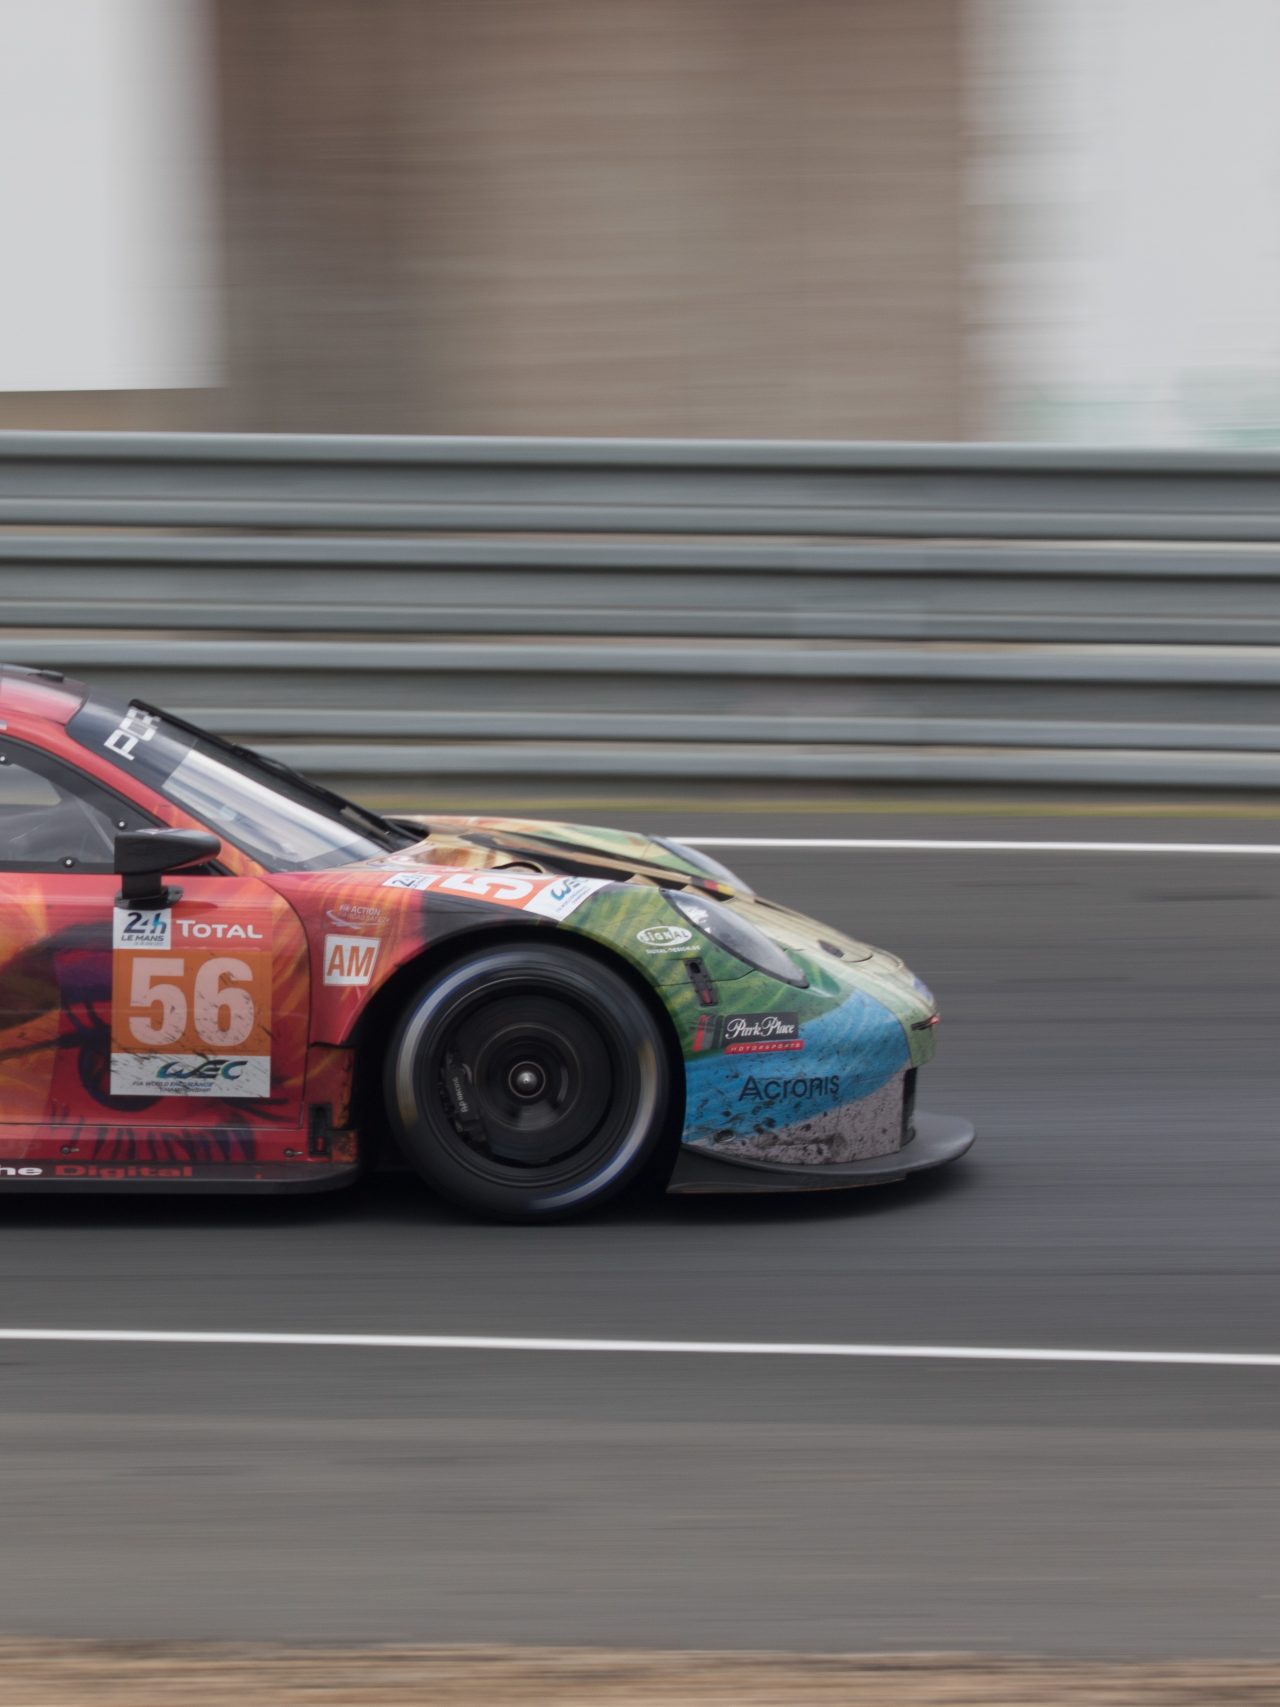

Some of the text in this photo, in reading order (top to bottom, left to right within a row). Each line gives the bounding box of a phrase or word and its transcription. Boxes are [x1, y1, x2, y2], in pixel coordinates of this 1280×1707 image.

[351, 905, 380, 917] ACTION
[135, 934, 165, 942] MANS
[326, 944, 376, 977] AM
[128, 957, 255, 1047] 56
[725, 1016, 795, 1040] Park Place
[156, 1059, 249, 1080] WEC
[55, 1164, 193, 1178] Digital
